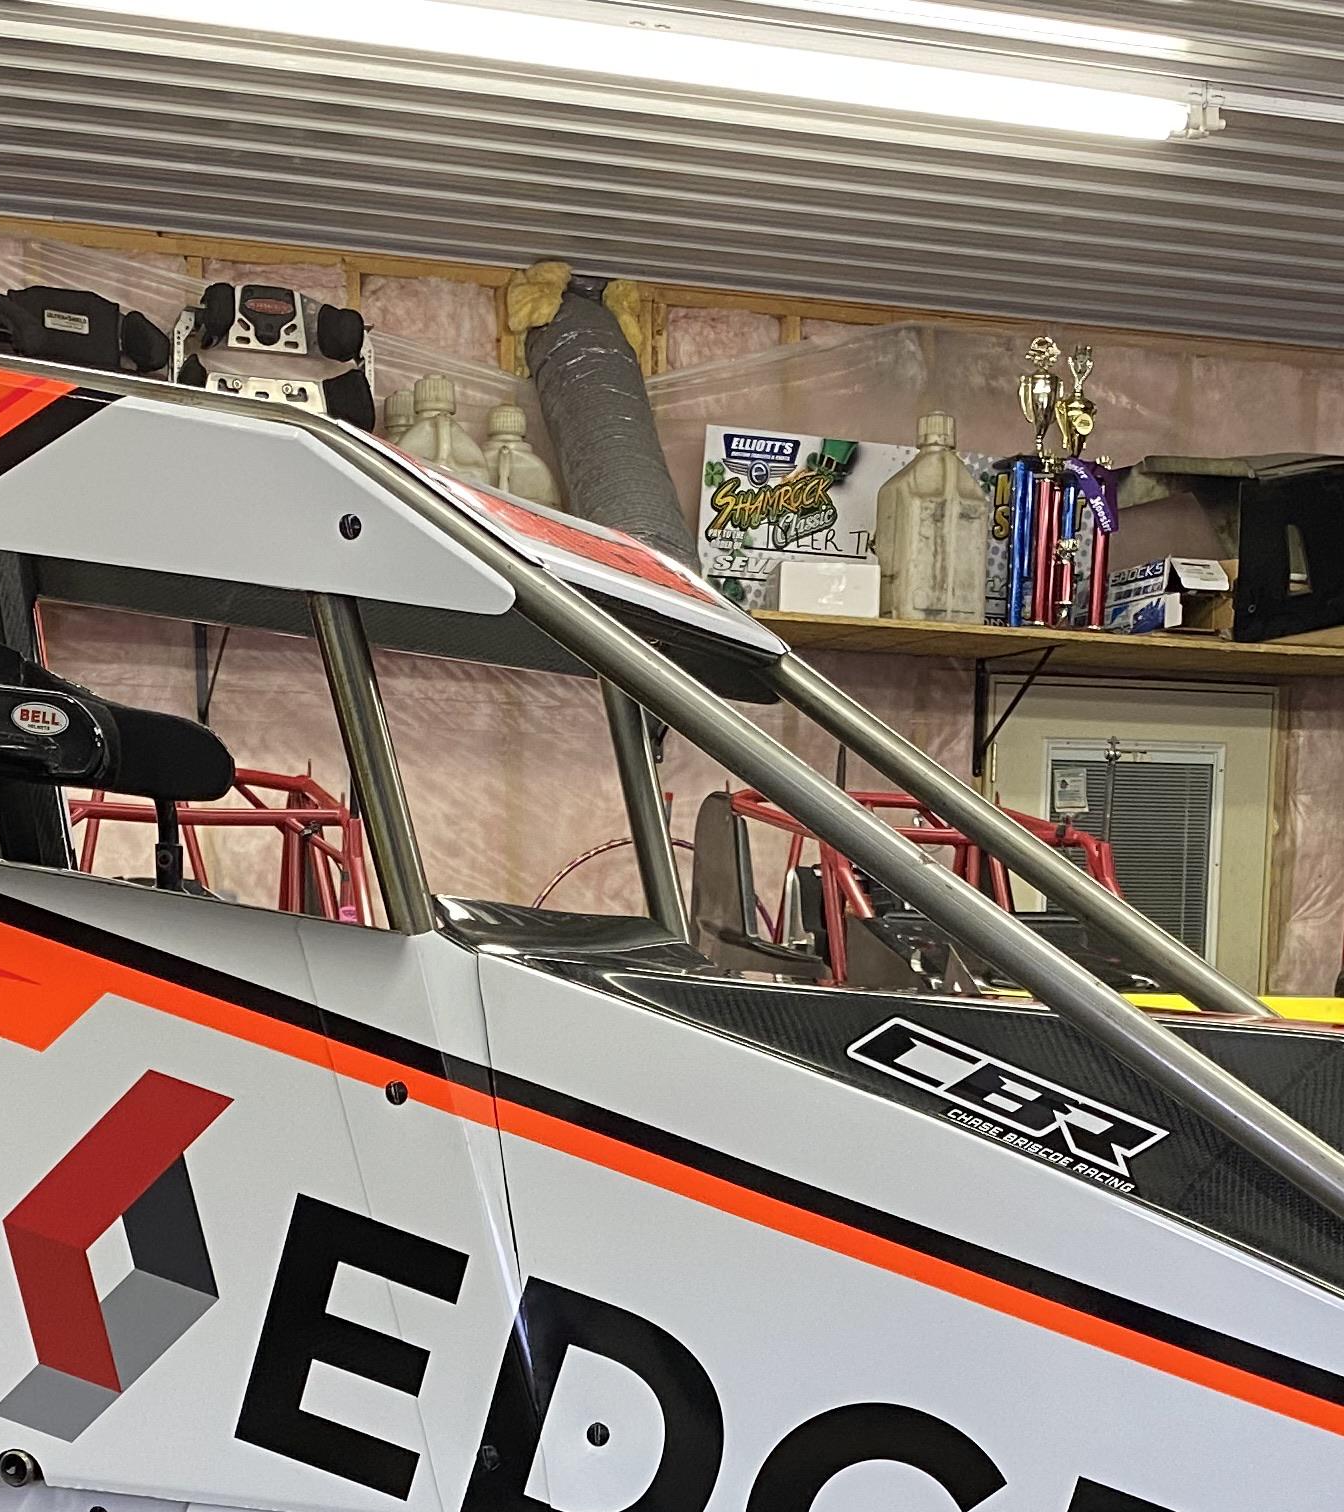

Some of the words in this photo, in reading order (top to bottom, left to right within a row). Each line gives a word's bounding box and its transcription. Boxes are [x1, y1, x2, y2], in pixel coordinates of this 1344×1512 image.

[731, 437, 794, 454] ELLIOTT'S
[1110, 560, 1165, 584] SHOCKS
[20, 709, 59, 726] BELL
[947, 1108, 1001, 1138] CHASE
[1004, 1132, 1073, 1167] BRISCOE
[1073, 1162, 1136, 1193] RACING
